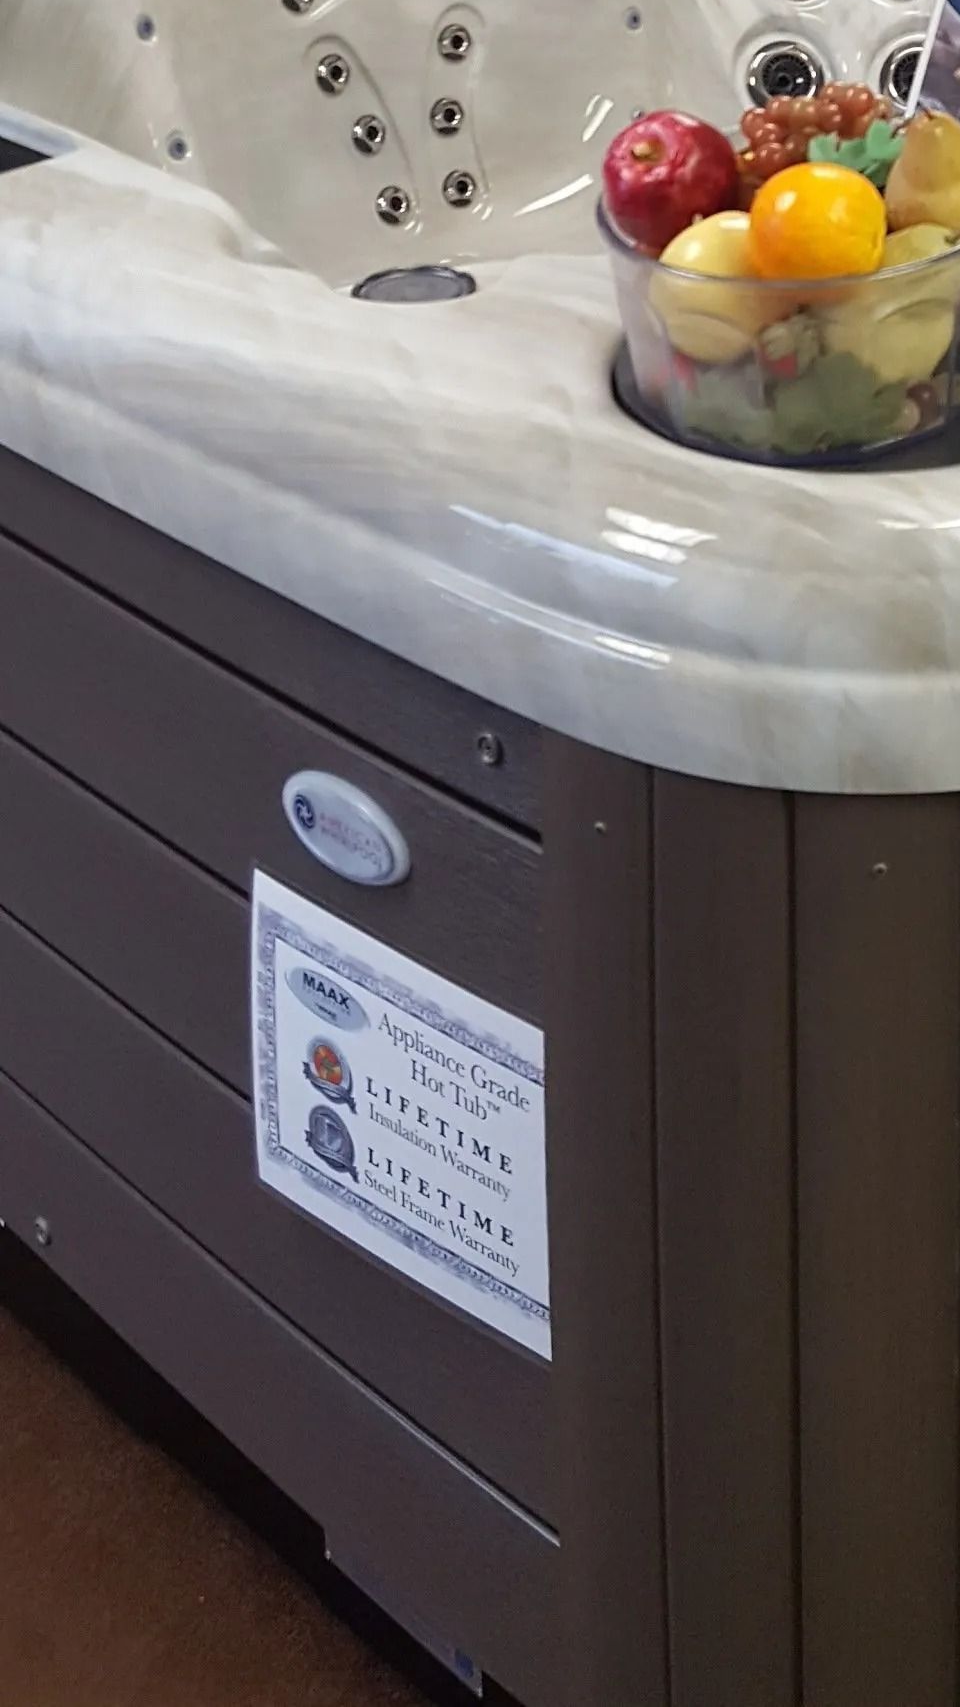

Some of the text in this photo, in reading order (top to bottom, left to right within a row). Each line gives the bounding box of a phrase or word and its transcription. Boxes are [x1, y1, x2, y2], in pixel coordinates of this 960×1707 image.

[303, 972, 350, 1009] MAAX
[378, 1013, 531, 1113] Appliance Grade
[410, 1059, 446, 1098] Hot
[366, 1076, 513, 1175] LIFETIME
[369, 1102, 511, 1202] Insulation Warranty
[363, 1169, 520, 1278] Steel Frame Warranty
[367, 1147, 514, 1247] LIFETIME
